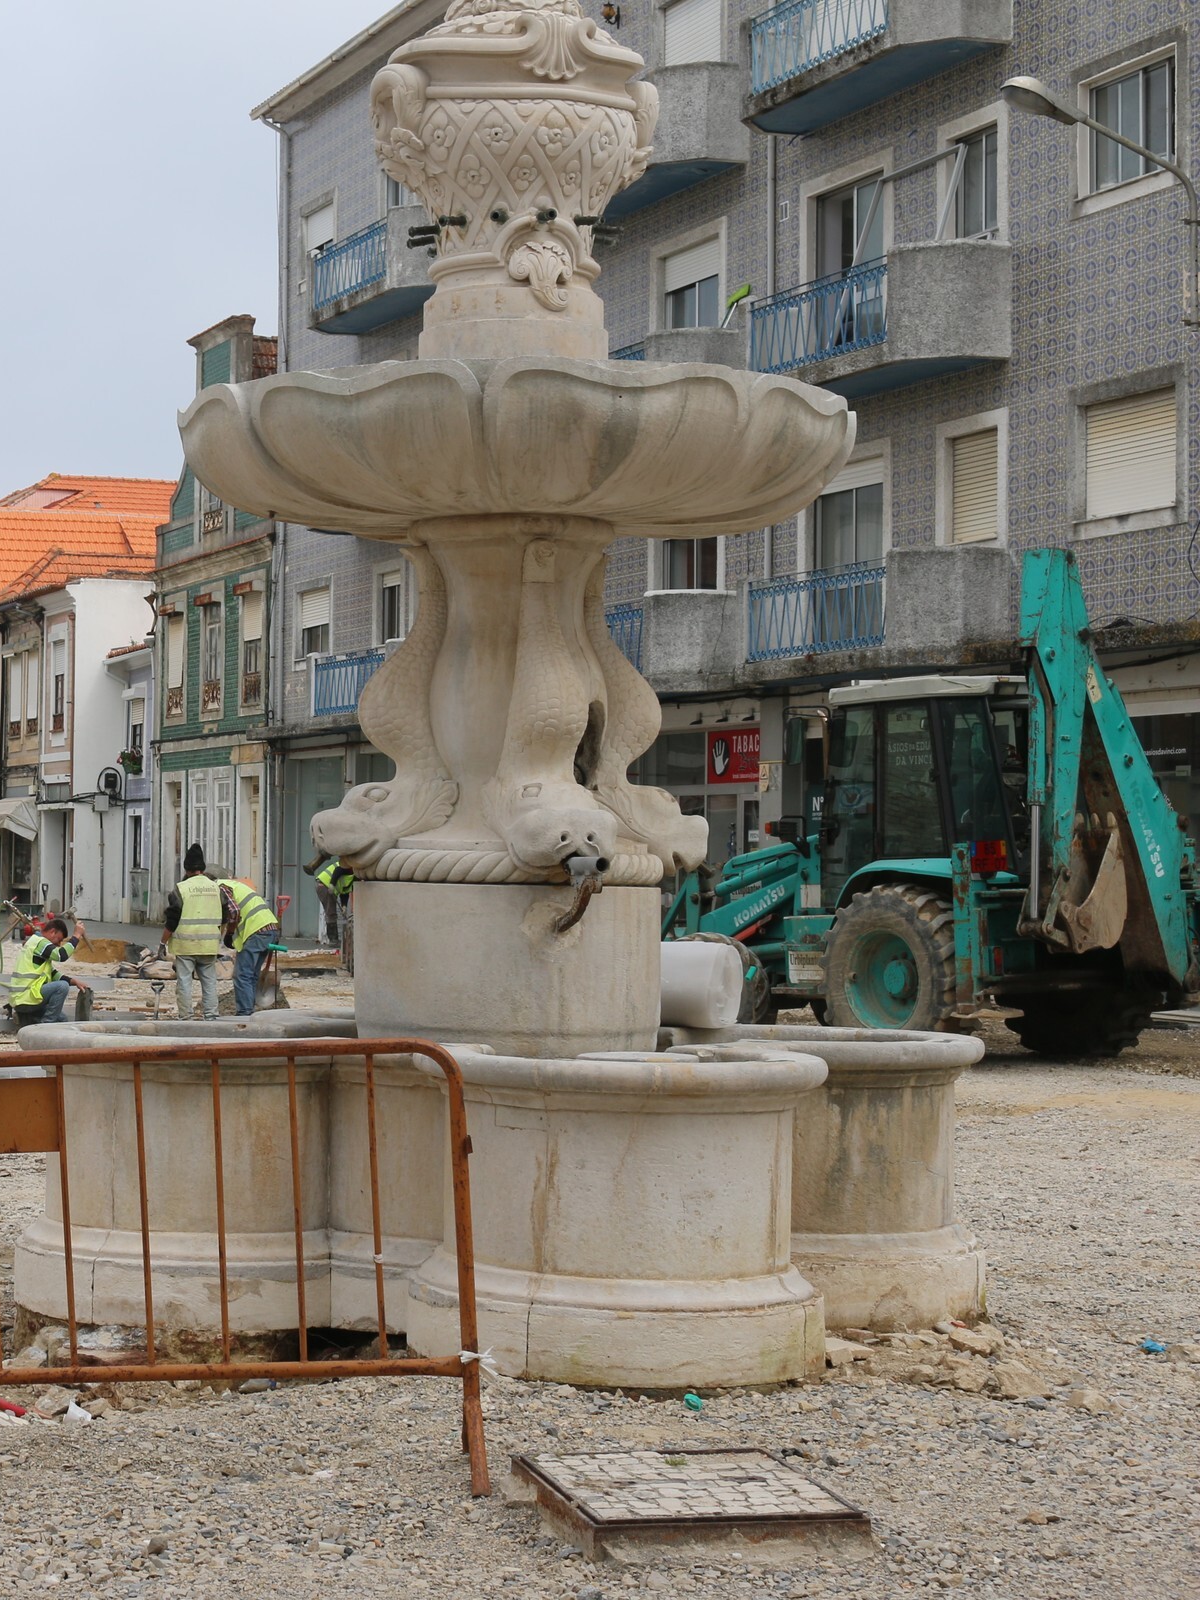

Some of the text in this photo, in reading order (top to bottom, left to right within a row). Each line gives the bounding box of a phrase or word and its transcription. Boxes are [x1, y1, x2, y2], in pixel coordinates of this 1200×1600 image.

[732, 734, 760, 753] TABAC
[895, 755, 907, 766] DA
[733, 884, 786, 927] KOMATSU
